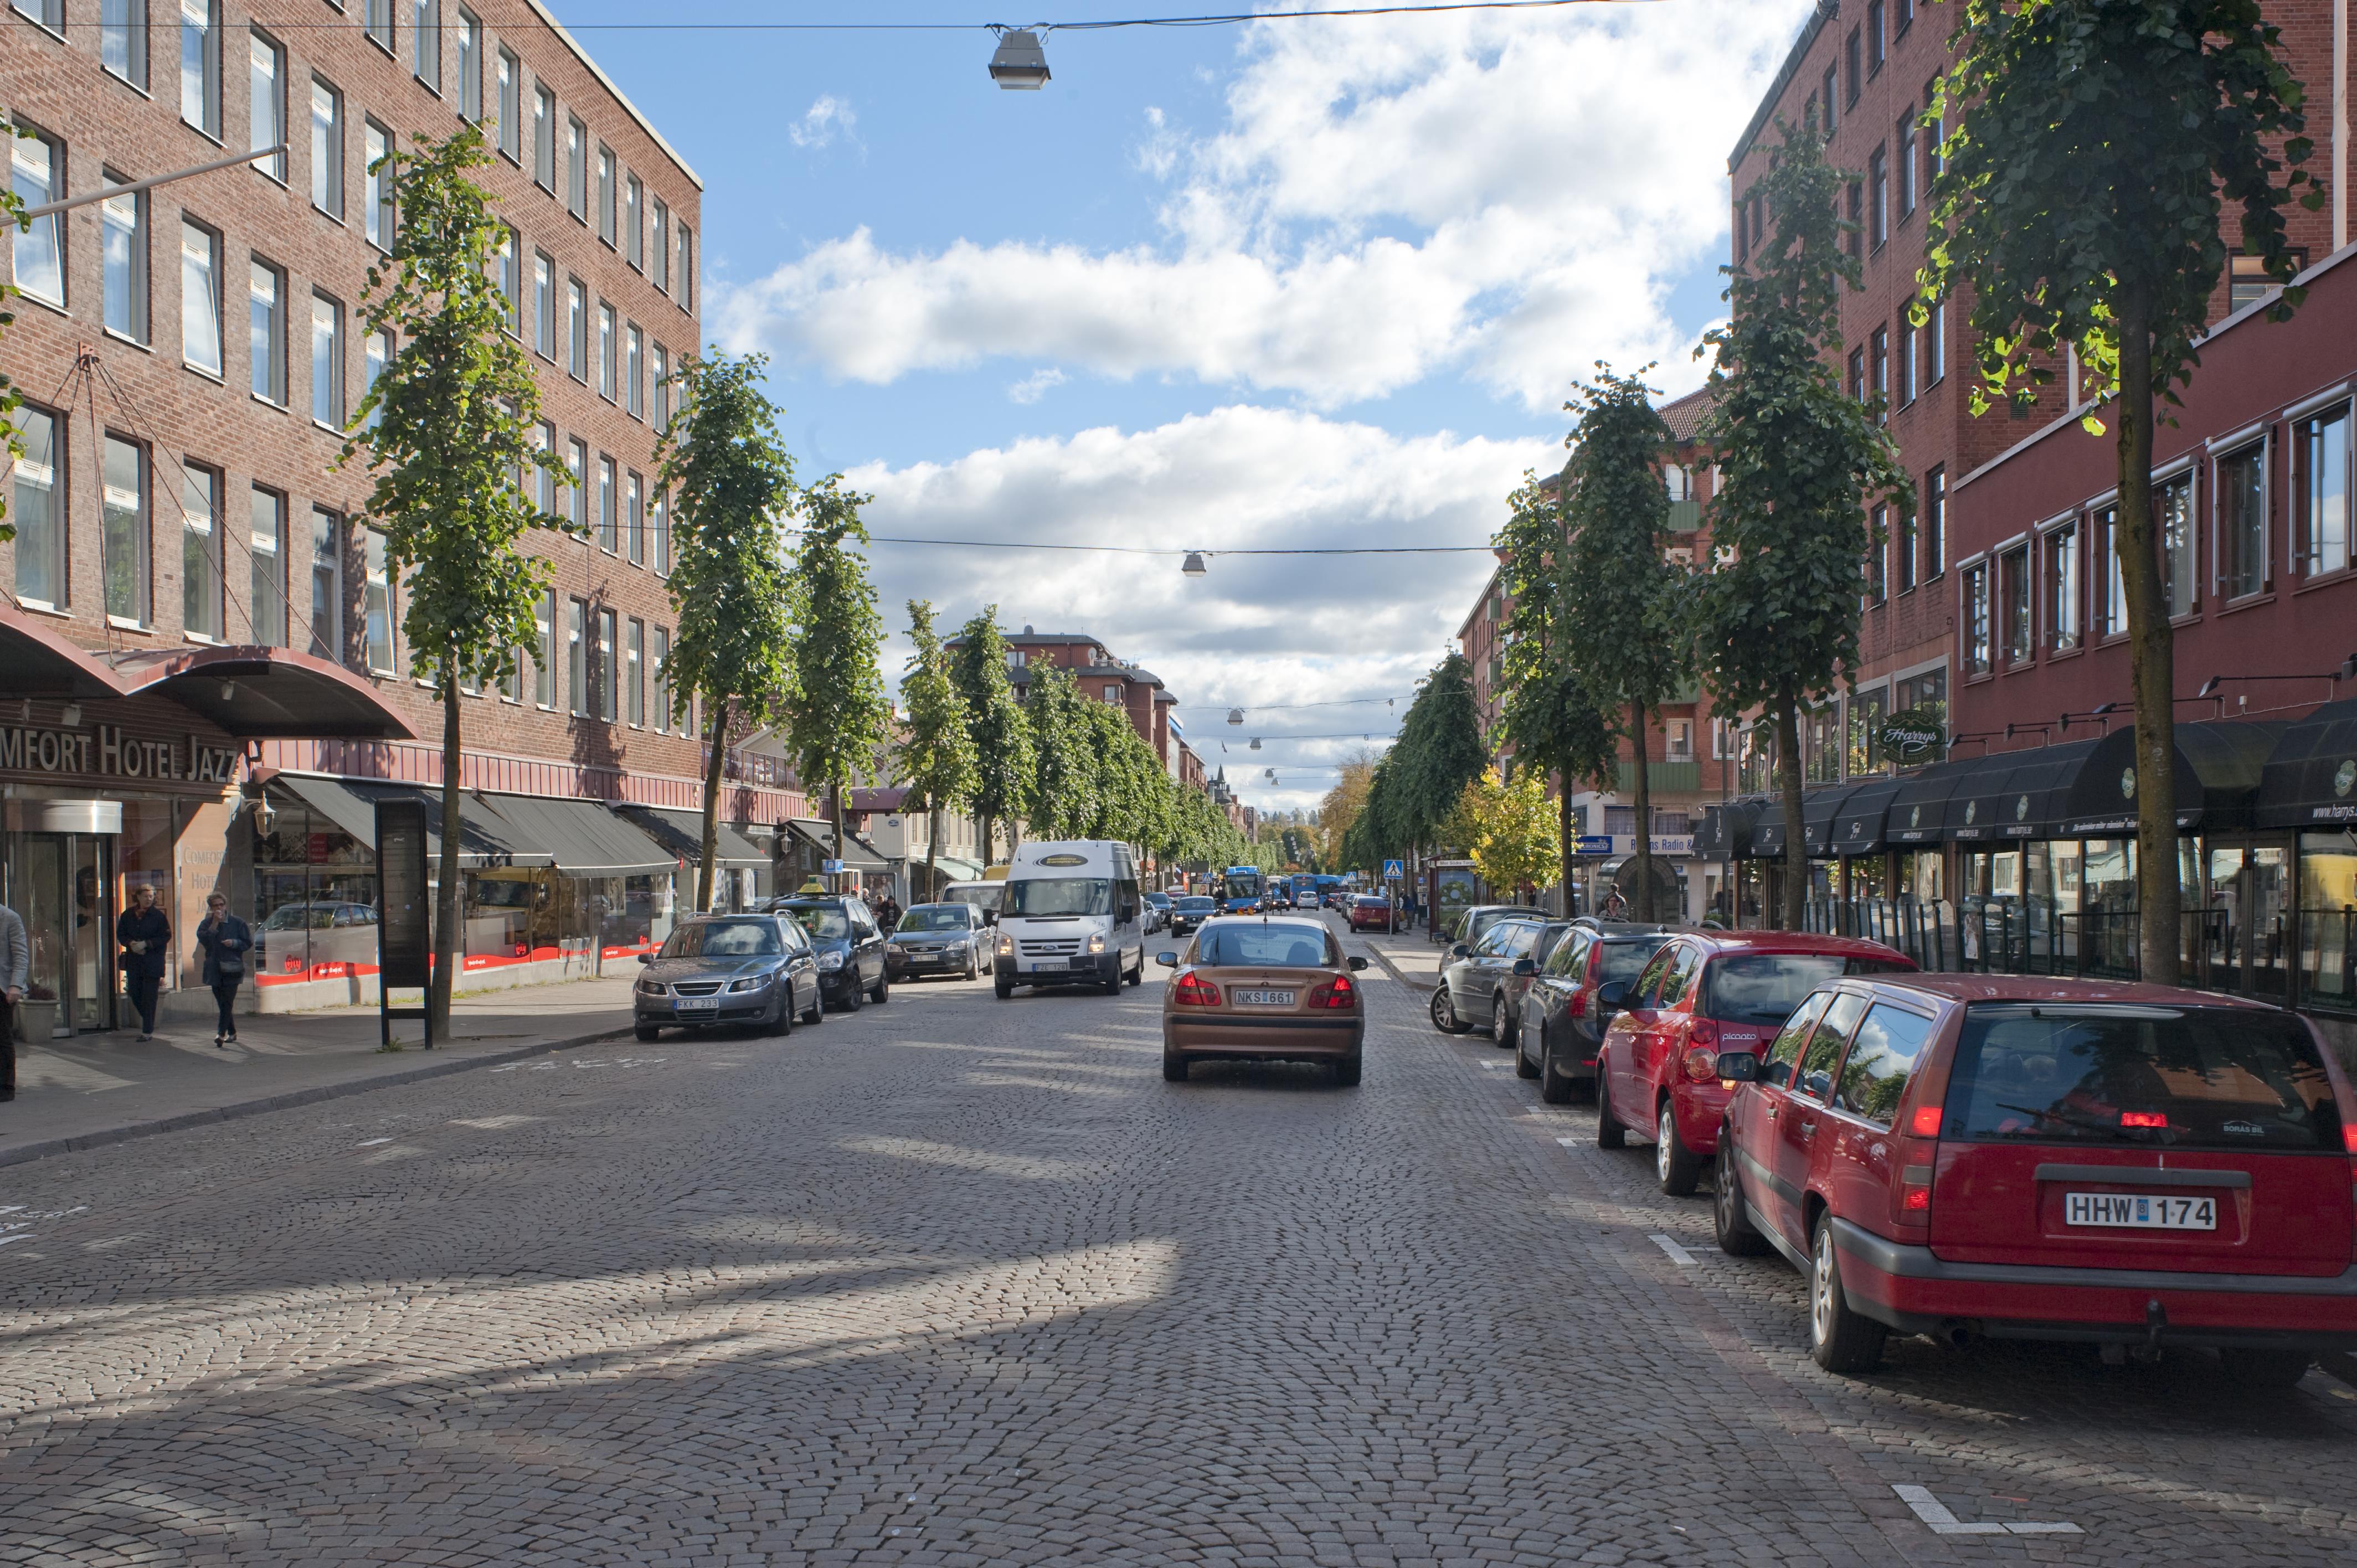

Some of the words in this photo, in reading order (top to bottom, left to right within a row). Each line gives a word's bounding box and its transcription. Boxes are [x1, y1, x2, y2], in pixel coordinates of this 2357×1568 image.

[1883, 728, 1936, 751] Harrys
[100, 725, 181, 779] HOTEL
[187, 735, 238, 783] JAZZ
[1662, 839, 1684, 850] Radio
[1237, 992, 1261, 1003] NKS
[1269, 993, 1290, 1003] 661
[678, 1000, 694, 1008] FKK
[701, 999, 717, 1008] 233
[1722, 1032, 1757, 1041] picanto
[2224, 1125, 2250, 1133] BORÅS
[2072, 1196, 2132, 1223] HHW
[2139, 1204, 2145, 1213] 8
[2157, 1199, 2212, 1226] 174
